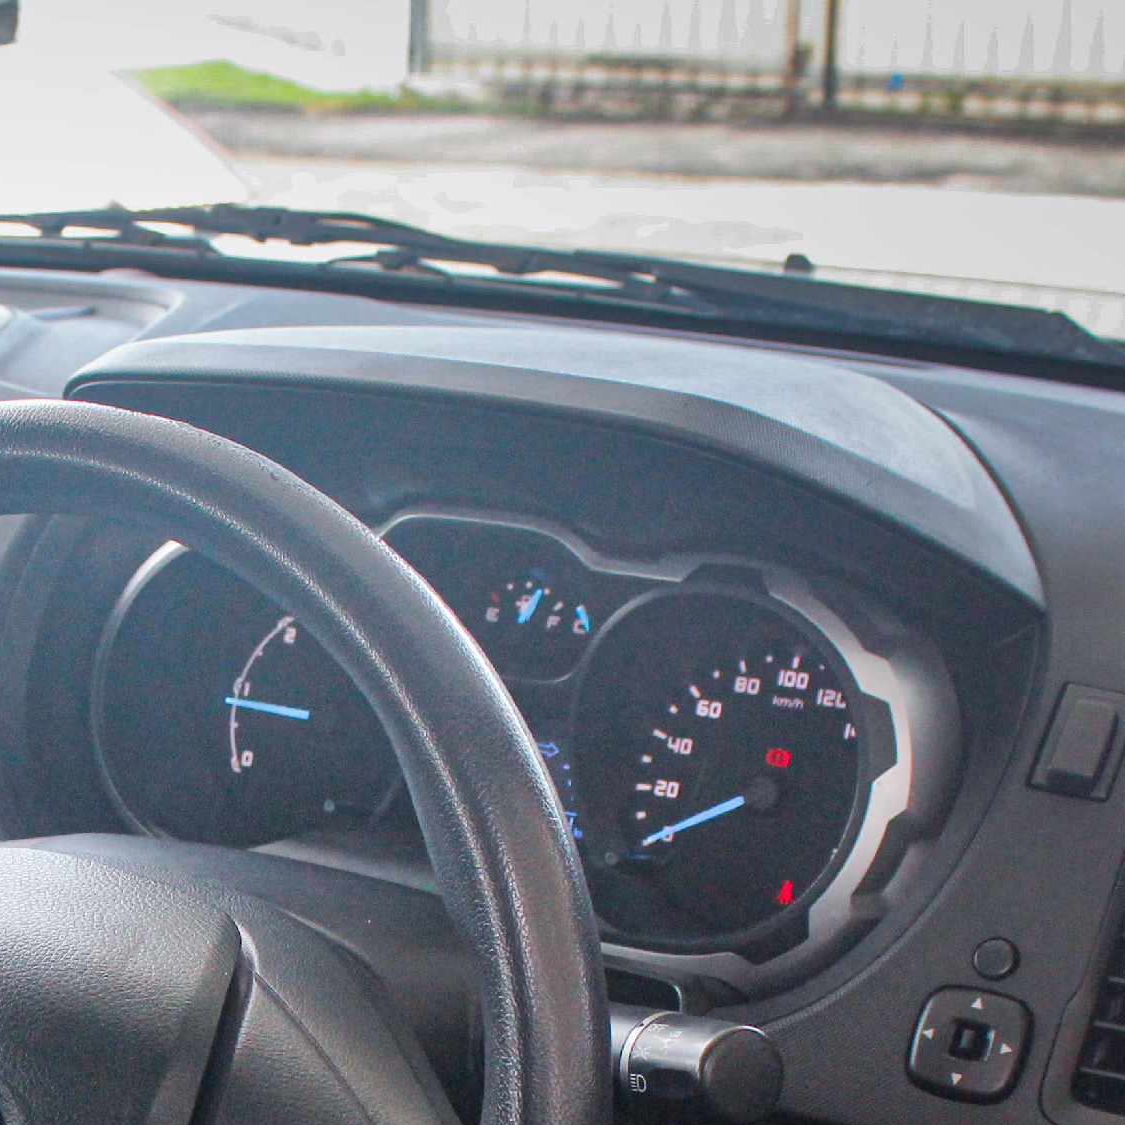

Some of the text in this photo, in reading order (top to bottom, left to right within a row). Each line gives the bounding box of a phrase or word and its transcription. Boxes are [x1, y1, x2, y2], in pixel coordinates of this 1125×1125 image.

[546, 615, 560, 630] F
[283, 626, 297, 645] 2
[734, 676, 761, 695] 80
[777, 669, 810, 690] 100
[243, 681, 251, 697] 1
[695, 699, 723, 719] 60
[772, 695, 805, 710] km/h
[667, 737, 694, 755] 40
[241, 750, 254, 767] 0
[653, 779, 680, 798] 20
